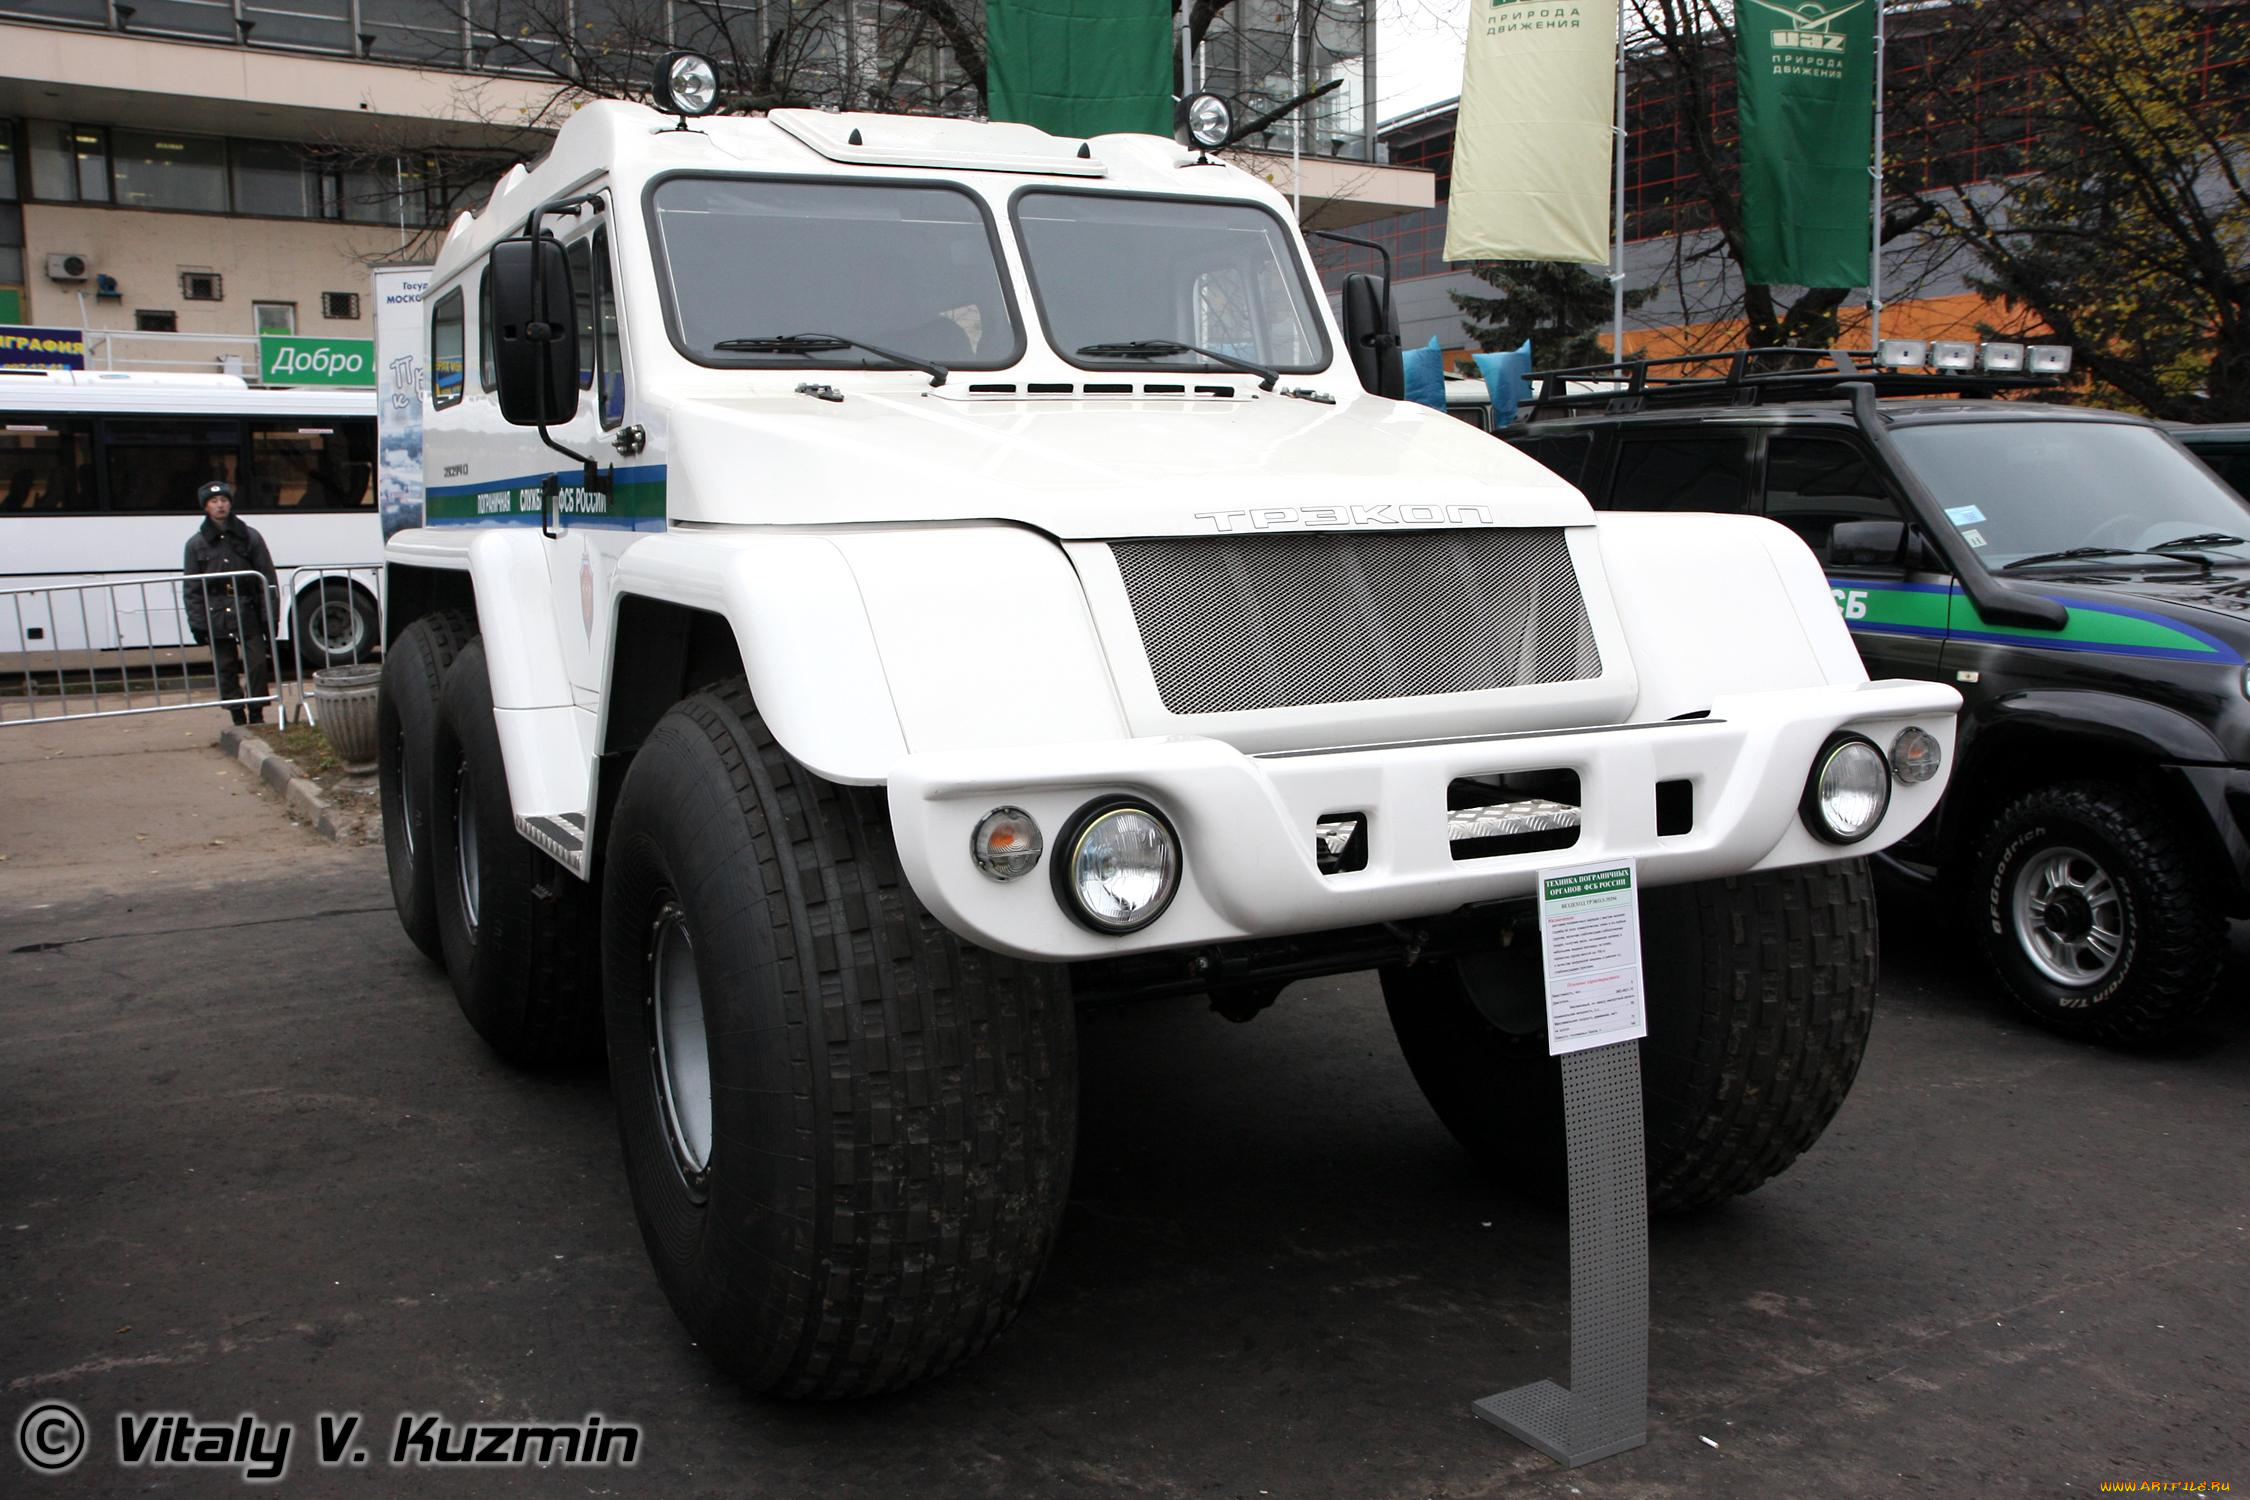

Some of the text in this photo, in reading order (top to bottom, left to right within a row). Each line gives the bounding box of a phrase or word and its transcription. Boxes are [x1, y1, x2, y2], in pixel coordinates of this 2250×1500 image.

[1488, 8, 1580, 24] ПРИРОДА
[1487, 19, 1580, 36] ДВИЖЕНИЯ
[1772, 55, 1843, 68] ПРИРОДА
[1773, 65, 1843, 78] ДВИЖЕНИЯ
[271, 347, 363, 377] Добро
[558, 487, 574, 513] ФСБ
[1545, 869, 1629, 888] ТЕХНИКА ПОГРАНИЧНЫХ
[1550, 878, 1626, 896] ОРГАНОВ ФСБ РОССИИ
[1990, 826, 2046, 935] BFGoodrich
